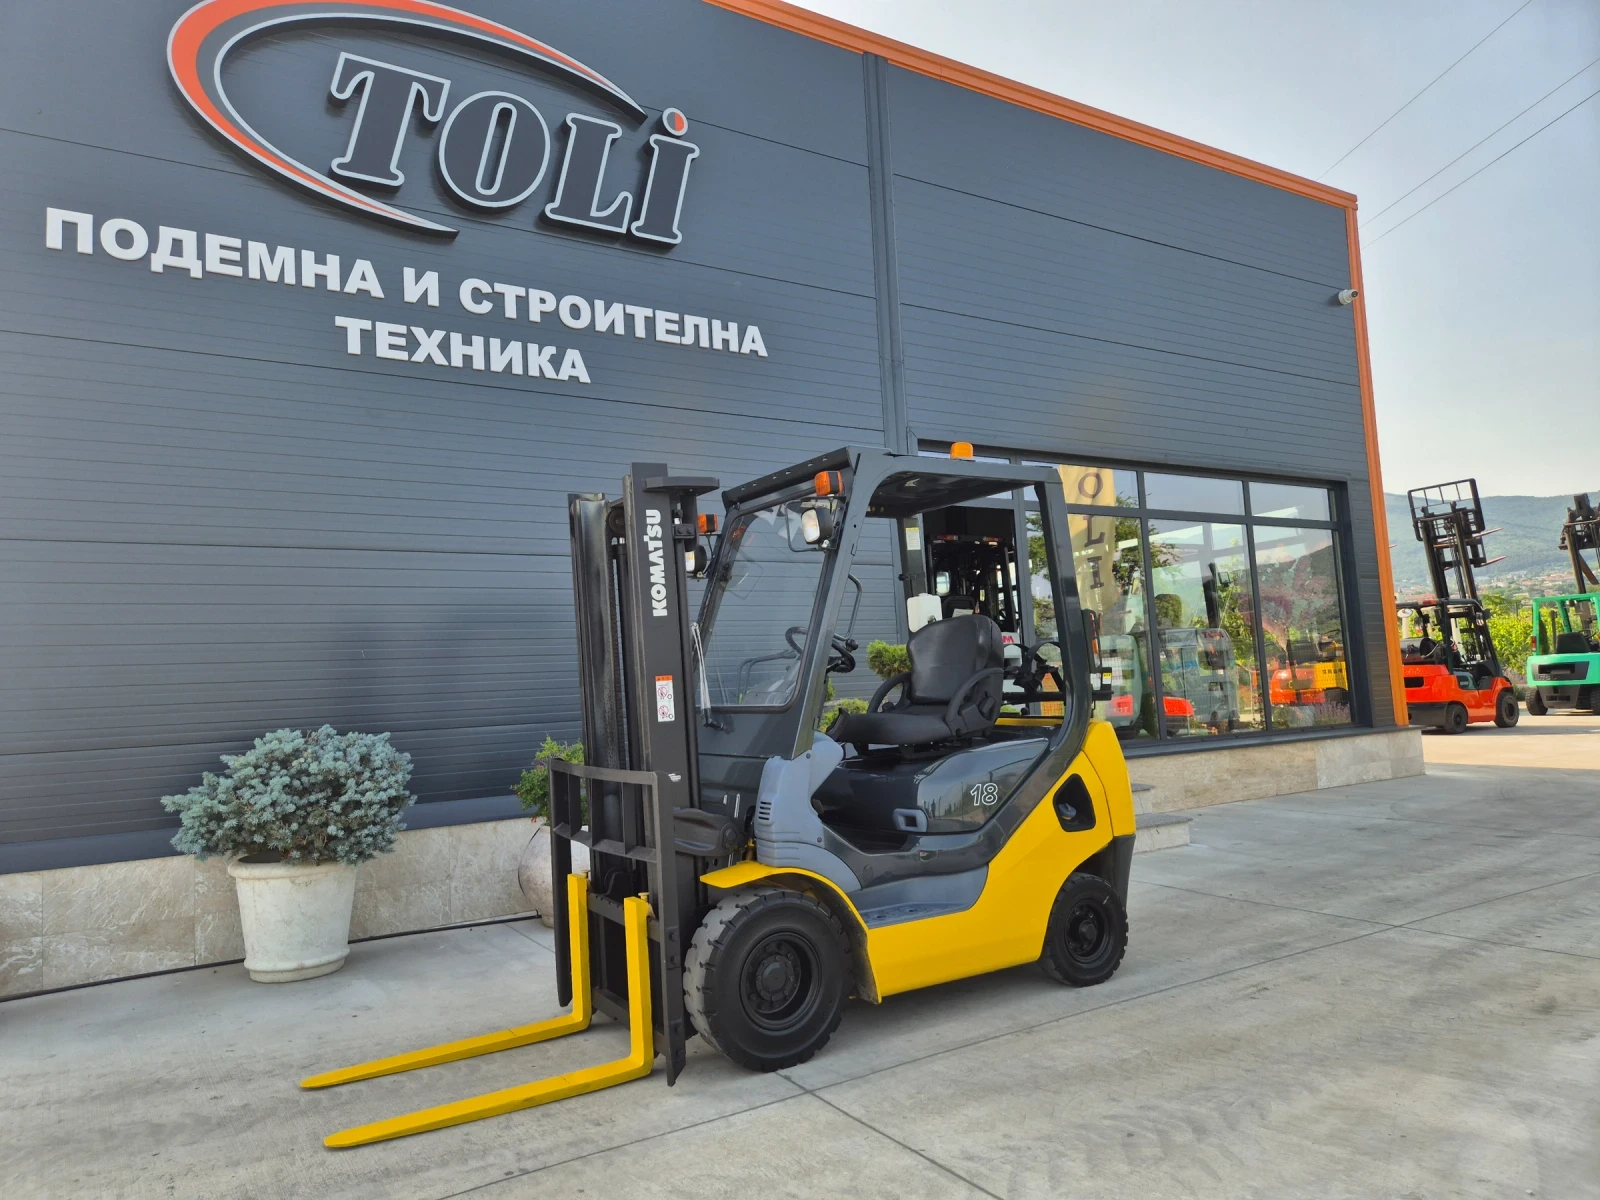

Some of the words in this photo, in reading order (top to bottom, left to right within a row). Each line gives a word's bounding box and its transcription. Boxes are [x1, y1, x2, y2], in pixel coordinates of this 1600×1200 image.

[45, 206, 385, 299] ПОДЕМНА
[403, 266, 440, 307] И
[459, 278, 769, 357] СТРОИТЕЛНА
[334, 315, 591, 384] ТЕХНИКА
[643, 509, 668, 617] KOMATSU
[970, 782, 998, 806] 18
